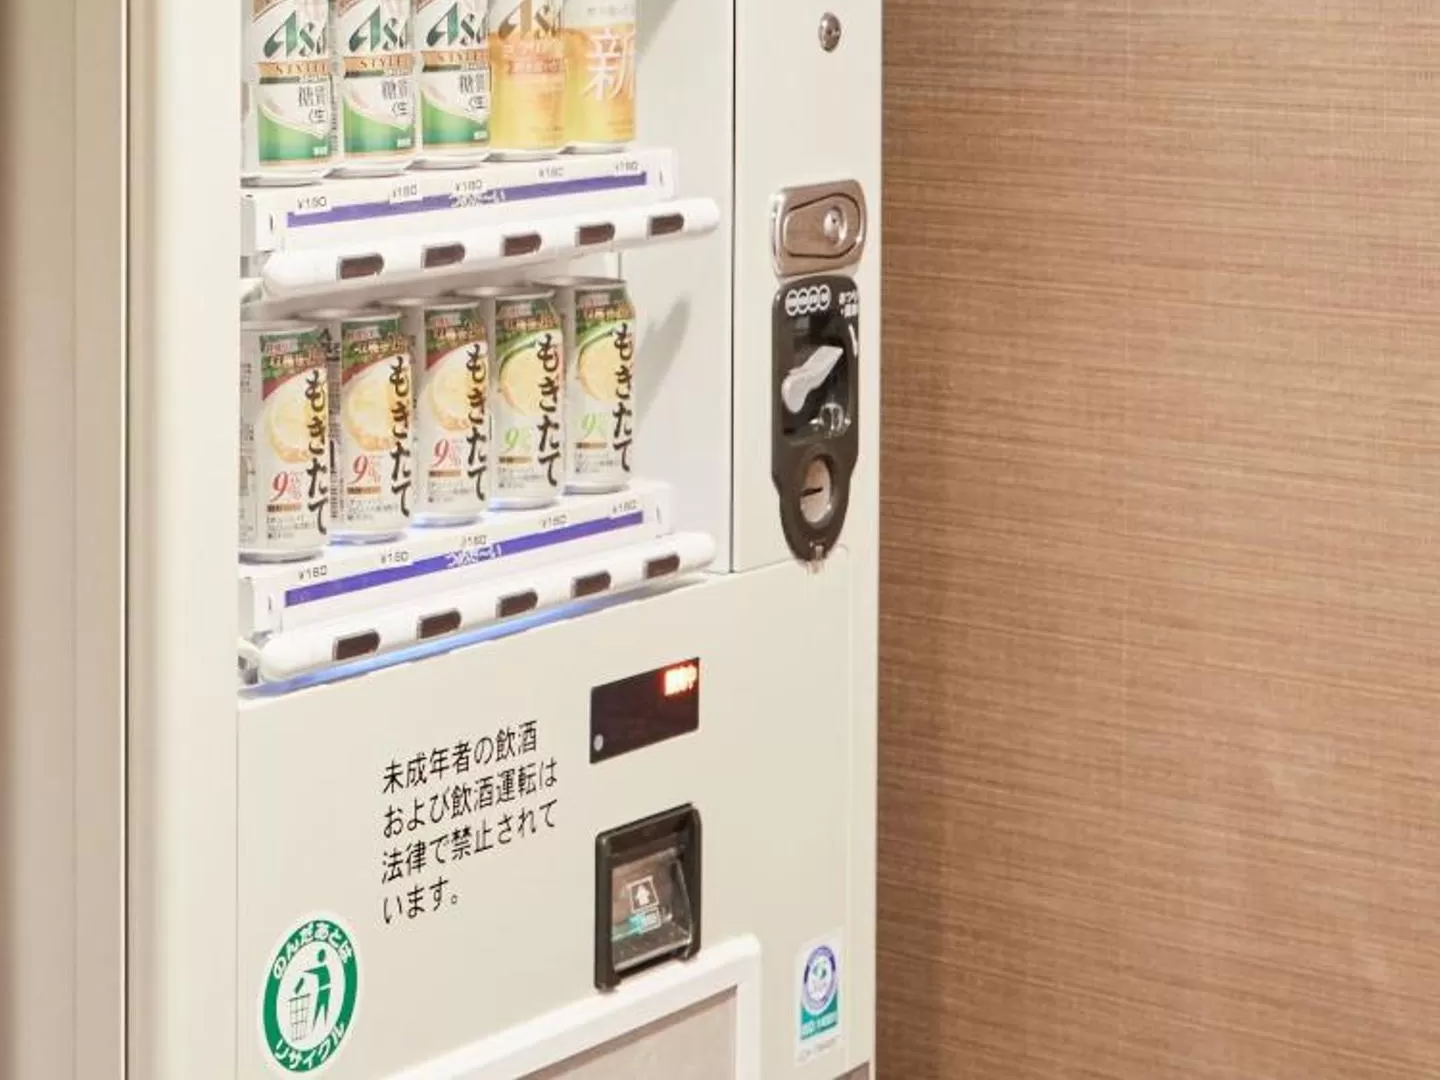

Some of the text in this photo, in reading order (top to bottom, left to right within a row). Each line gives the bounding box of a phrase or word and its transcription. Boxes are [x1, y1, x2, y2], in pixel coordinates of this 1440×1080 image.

[382, 720, 538, 795] 未成年者の飲酒
[383, 756, 558, 839] および飲酒運転は
[381, 799, 558, 884] 法律で禁止されて
[383, 876, 459, 925] います。
